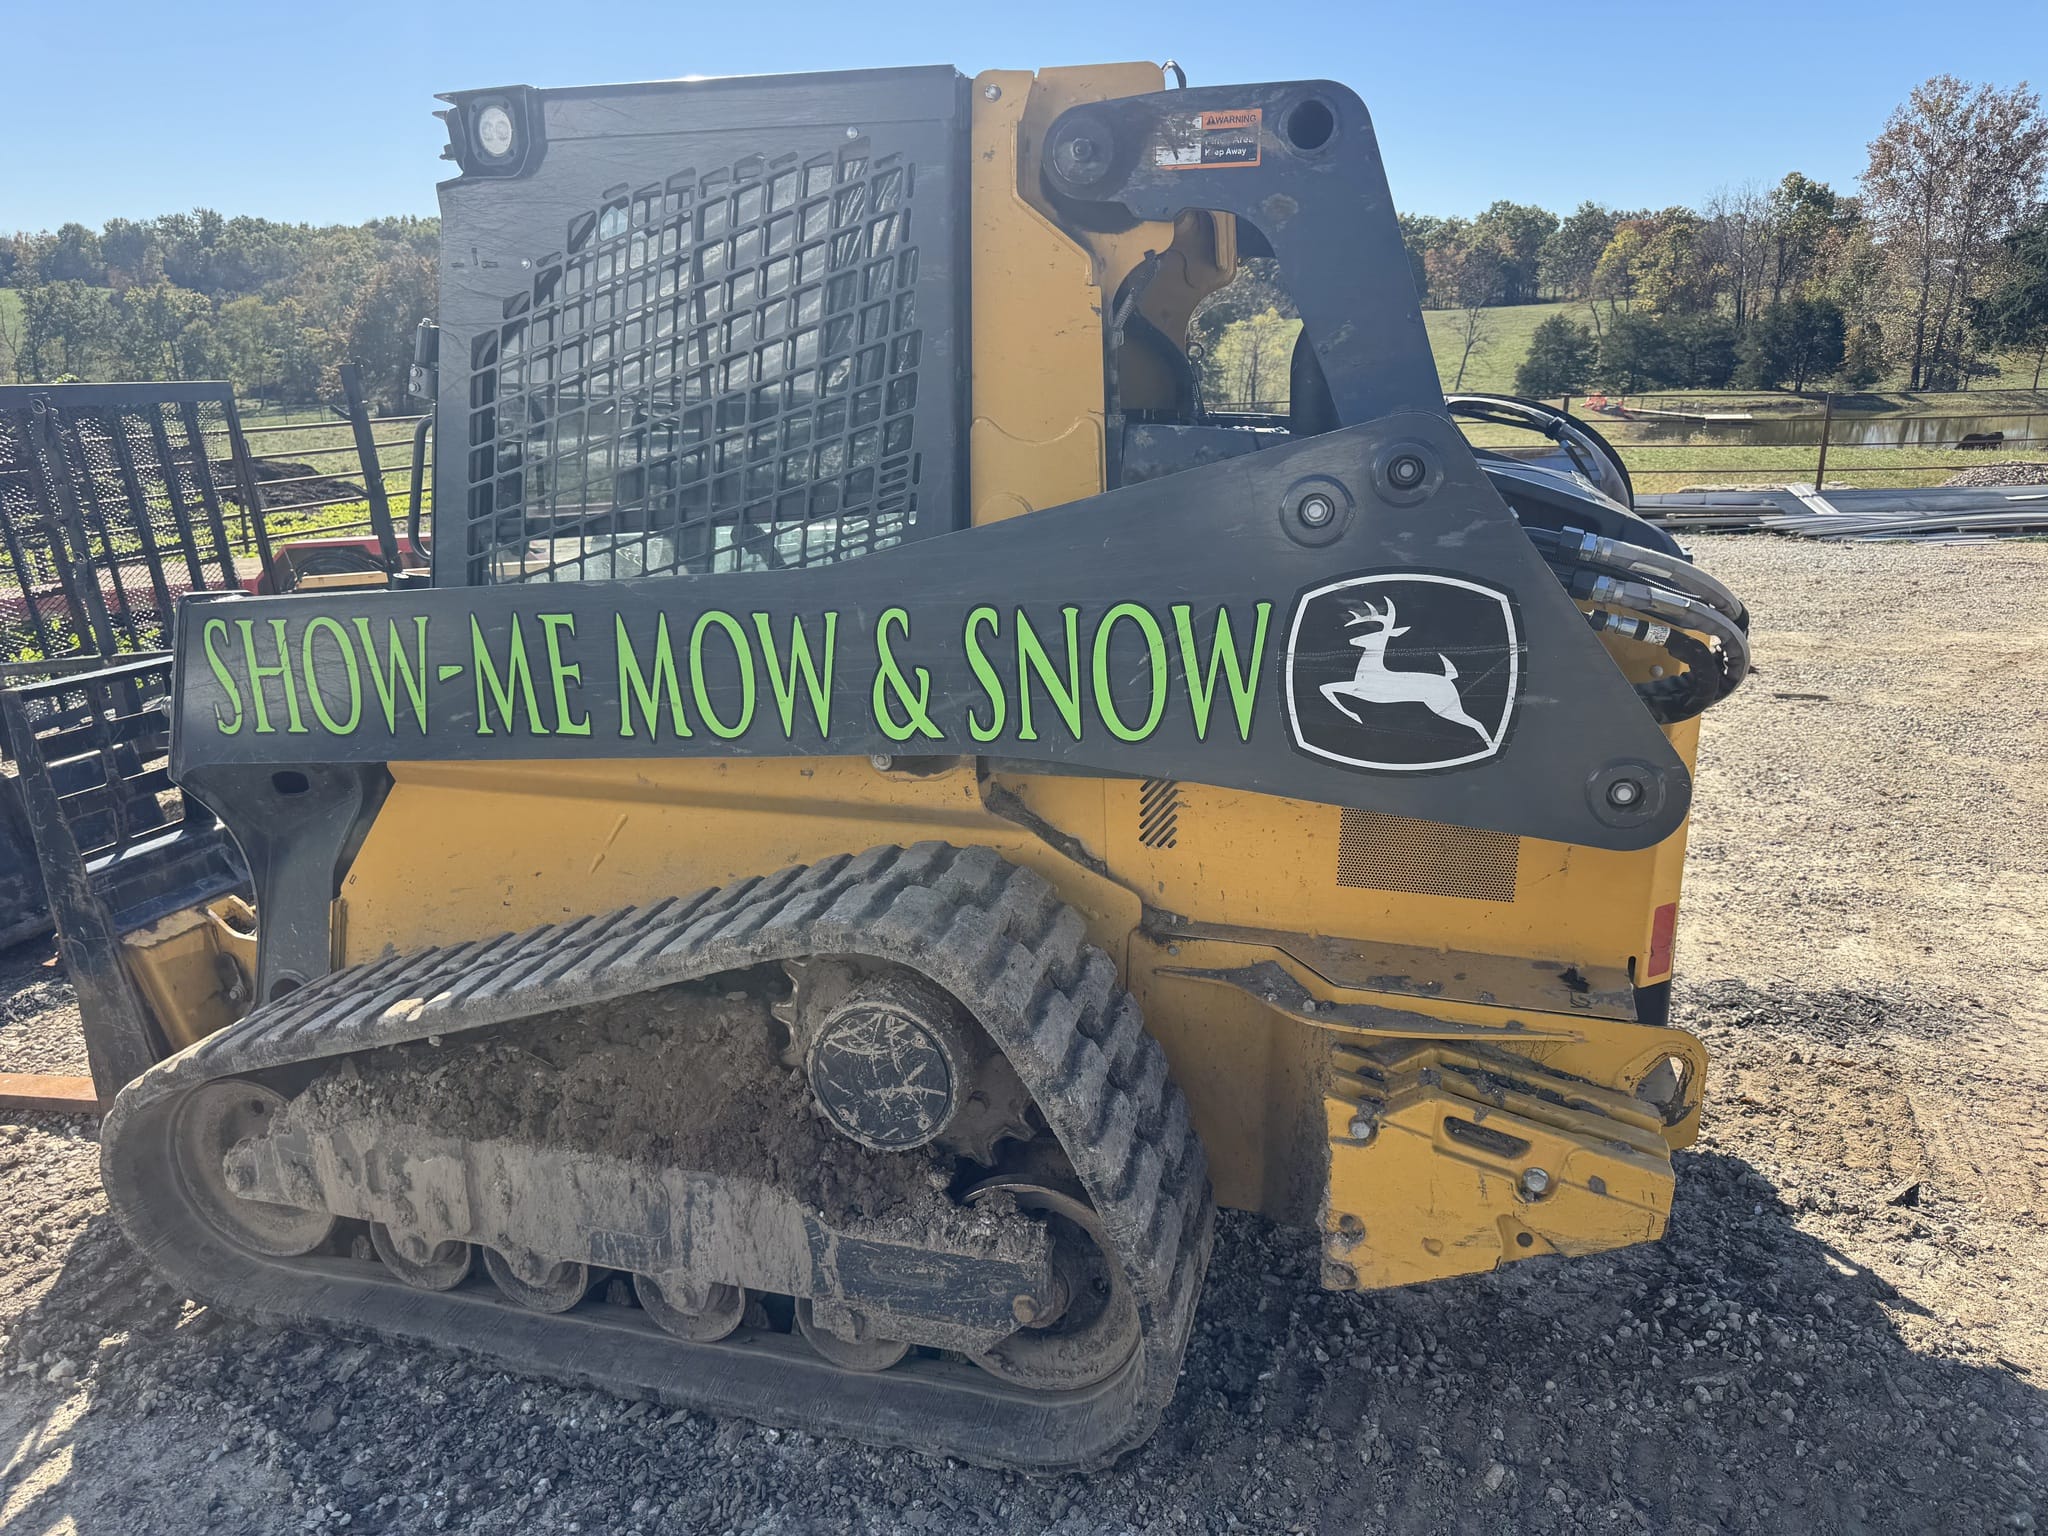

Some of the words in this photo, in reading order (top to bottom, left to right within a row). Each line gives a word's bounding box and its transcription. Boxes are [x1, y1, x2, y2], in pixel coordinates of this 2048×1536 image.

[1215, 114, 1257, 125] WARNING
[1204, 148, 1225, 157] Kep
[1225, 147, 1247, 156] Away
[203, 614, 592, 736] SHOW-ME
[617, 612, 836, 739] MOW
[873, 608, 944, 741] &
[964, 602, 1272, 742] SNOW
